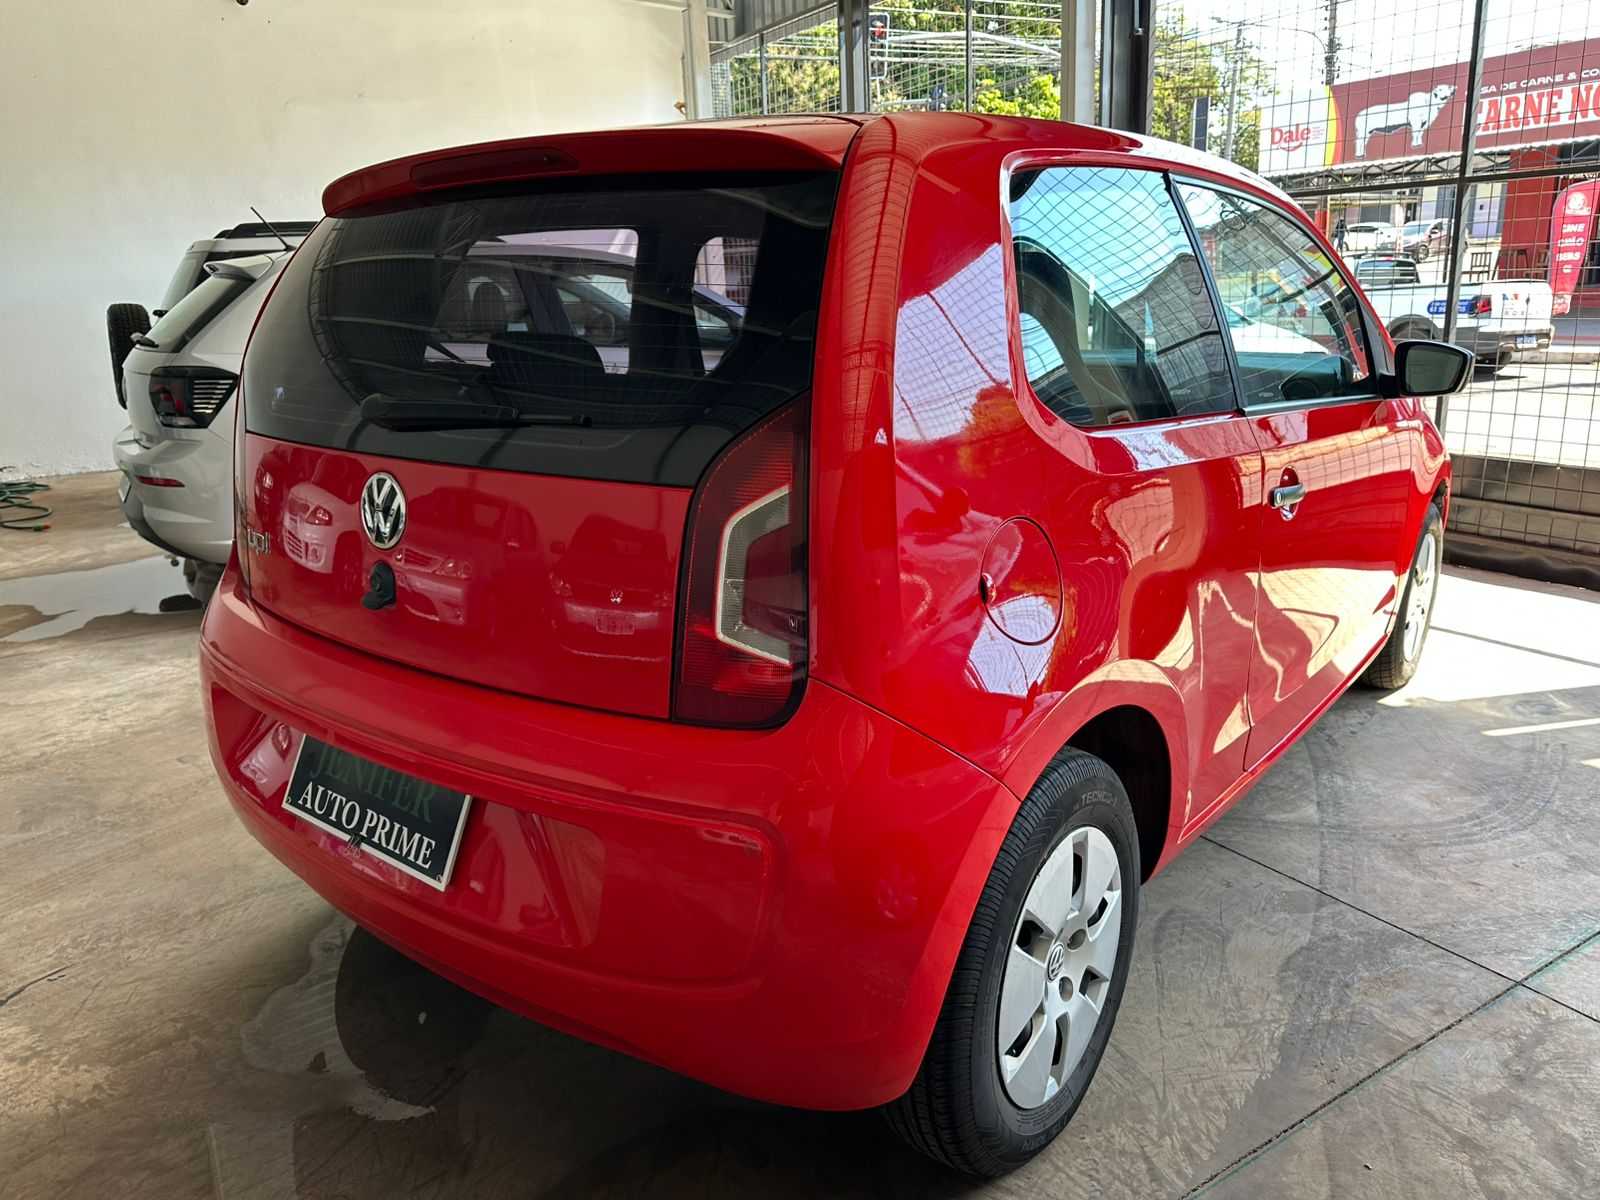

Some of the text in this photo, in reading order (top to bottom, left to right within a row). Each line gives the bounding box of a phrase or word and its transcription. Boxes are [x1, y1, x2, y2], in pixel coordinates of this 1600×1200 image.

[1500, 81, 1517, 91] DE
[1520, 73, 1564, 88] CARNE
[1477, 88, 1564, 132] ARNE
[1270, 122, 1312, 145] Dale
[309, 741, 432, 824] JENIFER
[296, 780, 437, 871] AUTO PRIME
